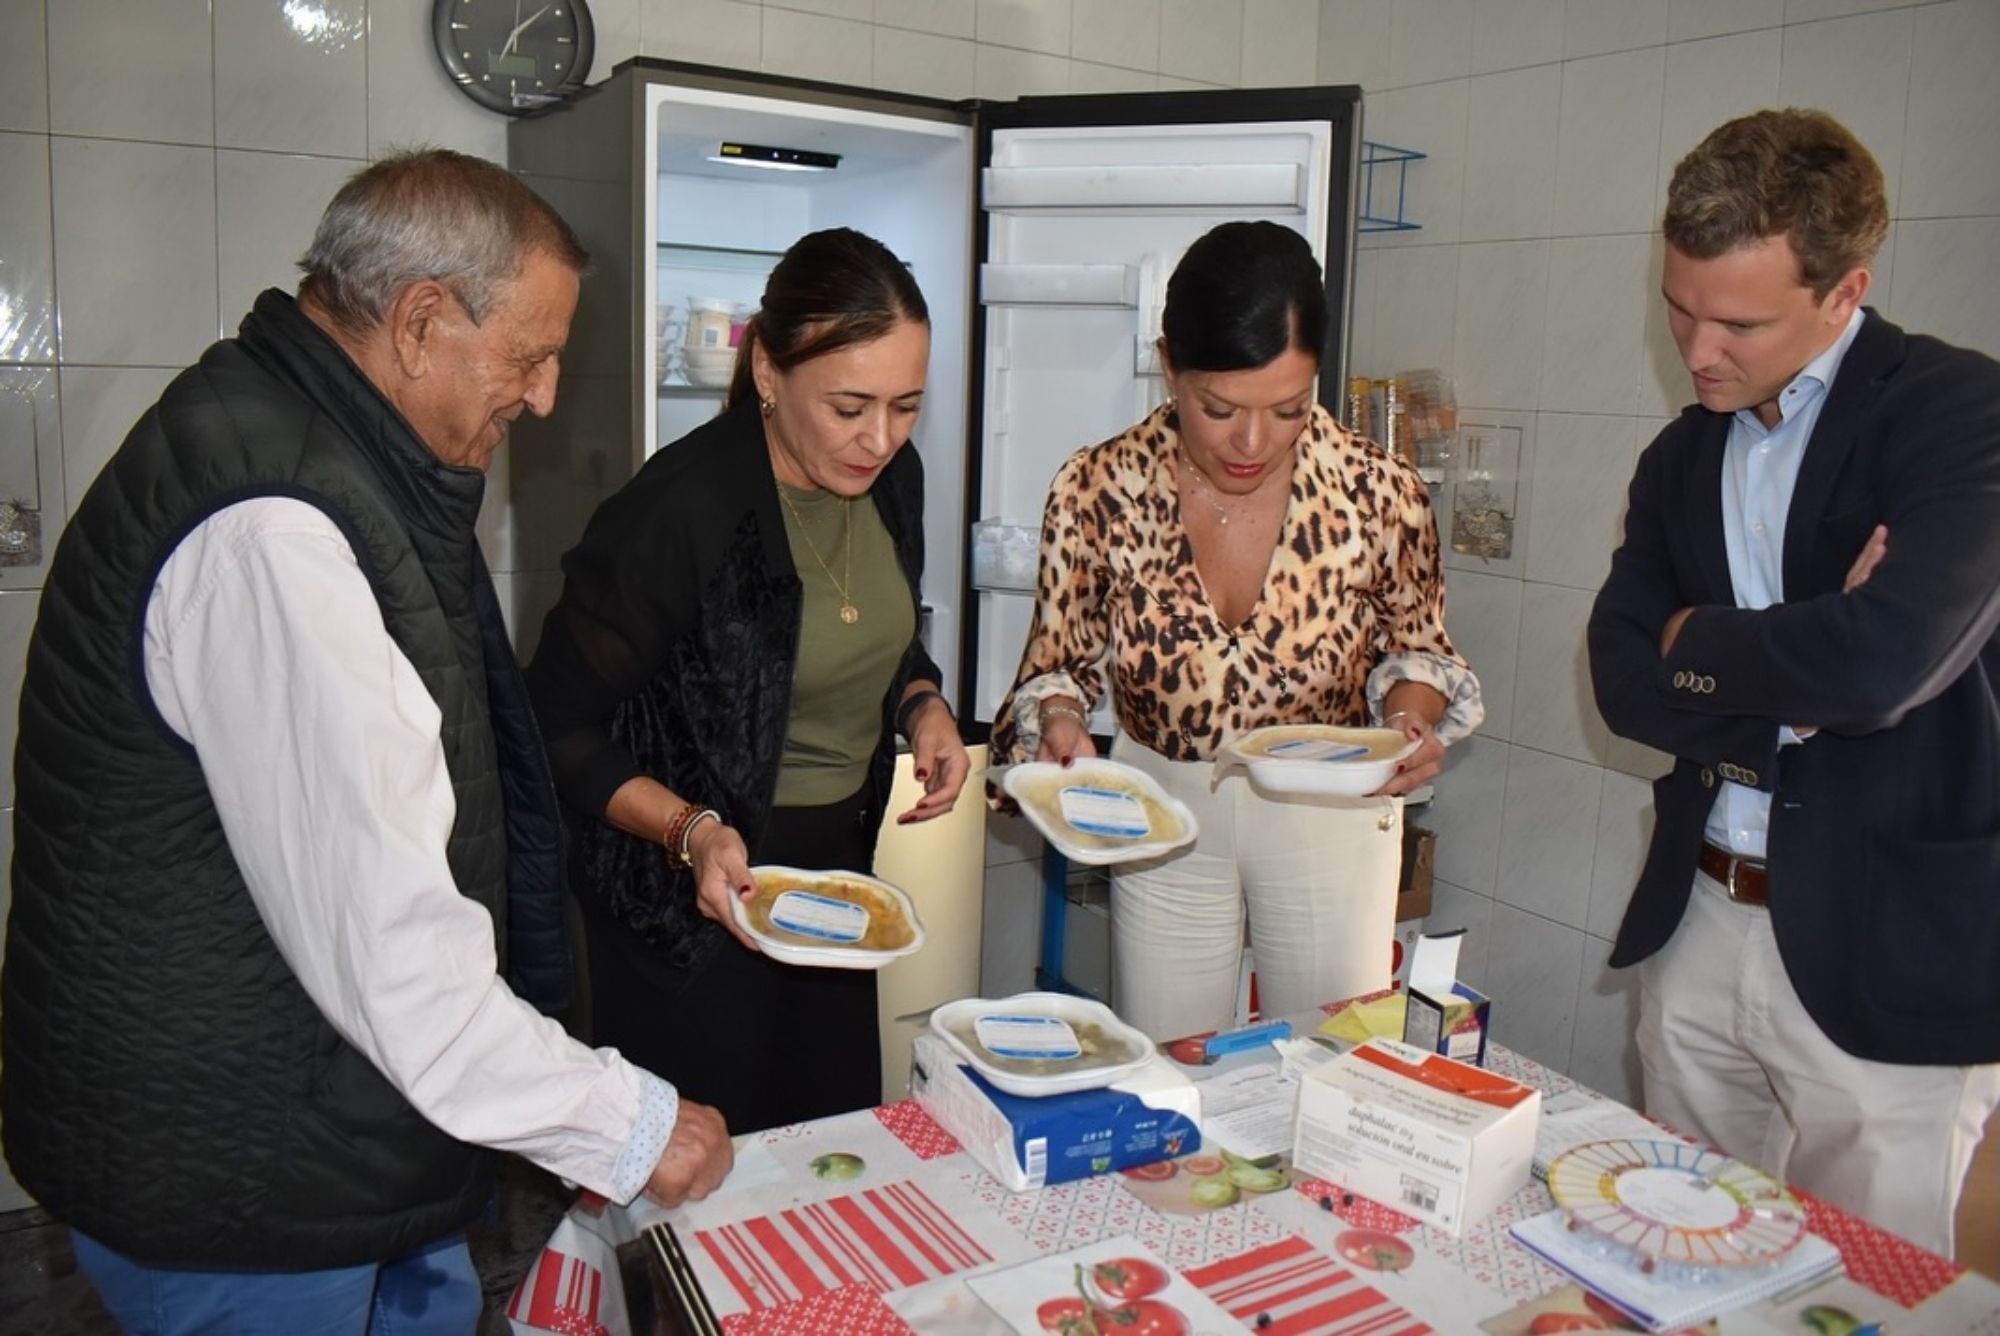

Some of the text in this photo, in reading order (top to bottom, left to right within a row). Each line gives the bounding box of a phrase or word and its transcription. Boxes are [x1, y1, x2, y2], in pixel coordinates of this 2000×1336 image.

[1392, 1142, 1415, 1156] oral
[1415, 1151, 1430, 1163] en
[1432, 1157, 1463, 1174] sobre
